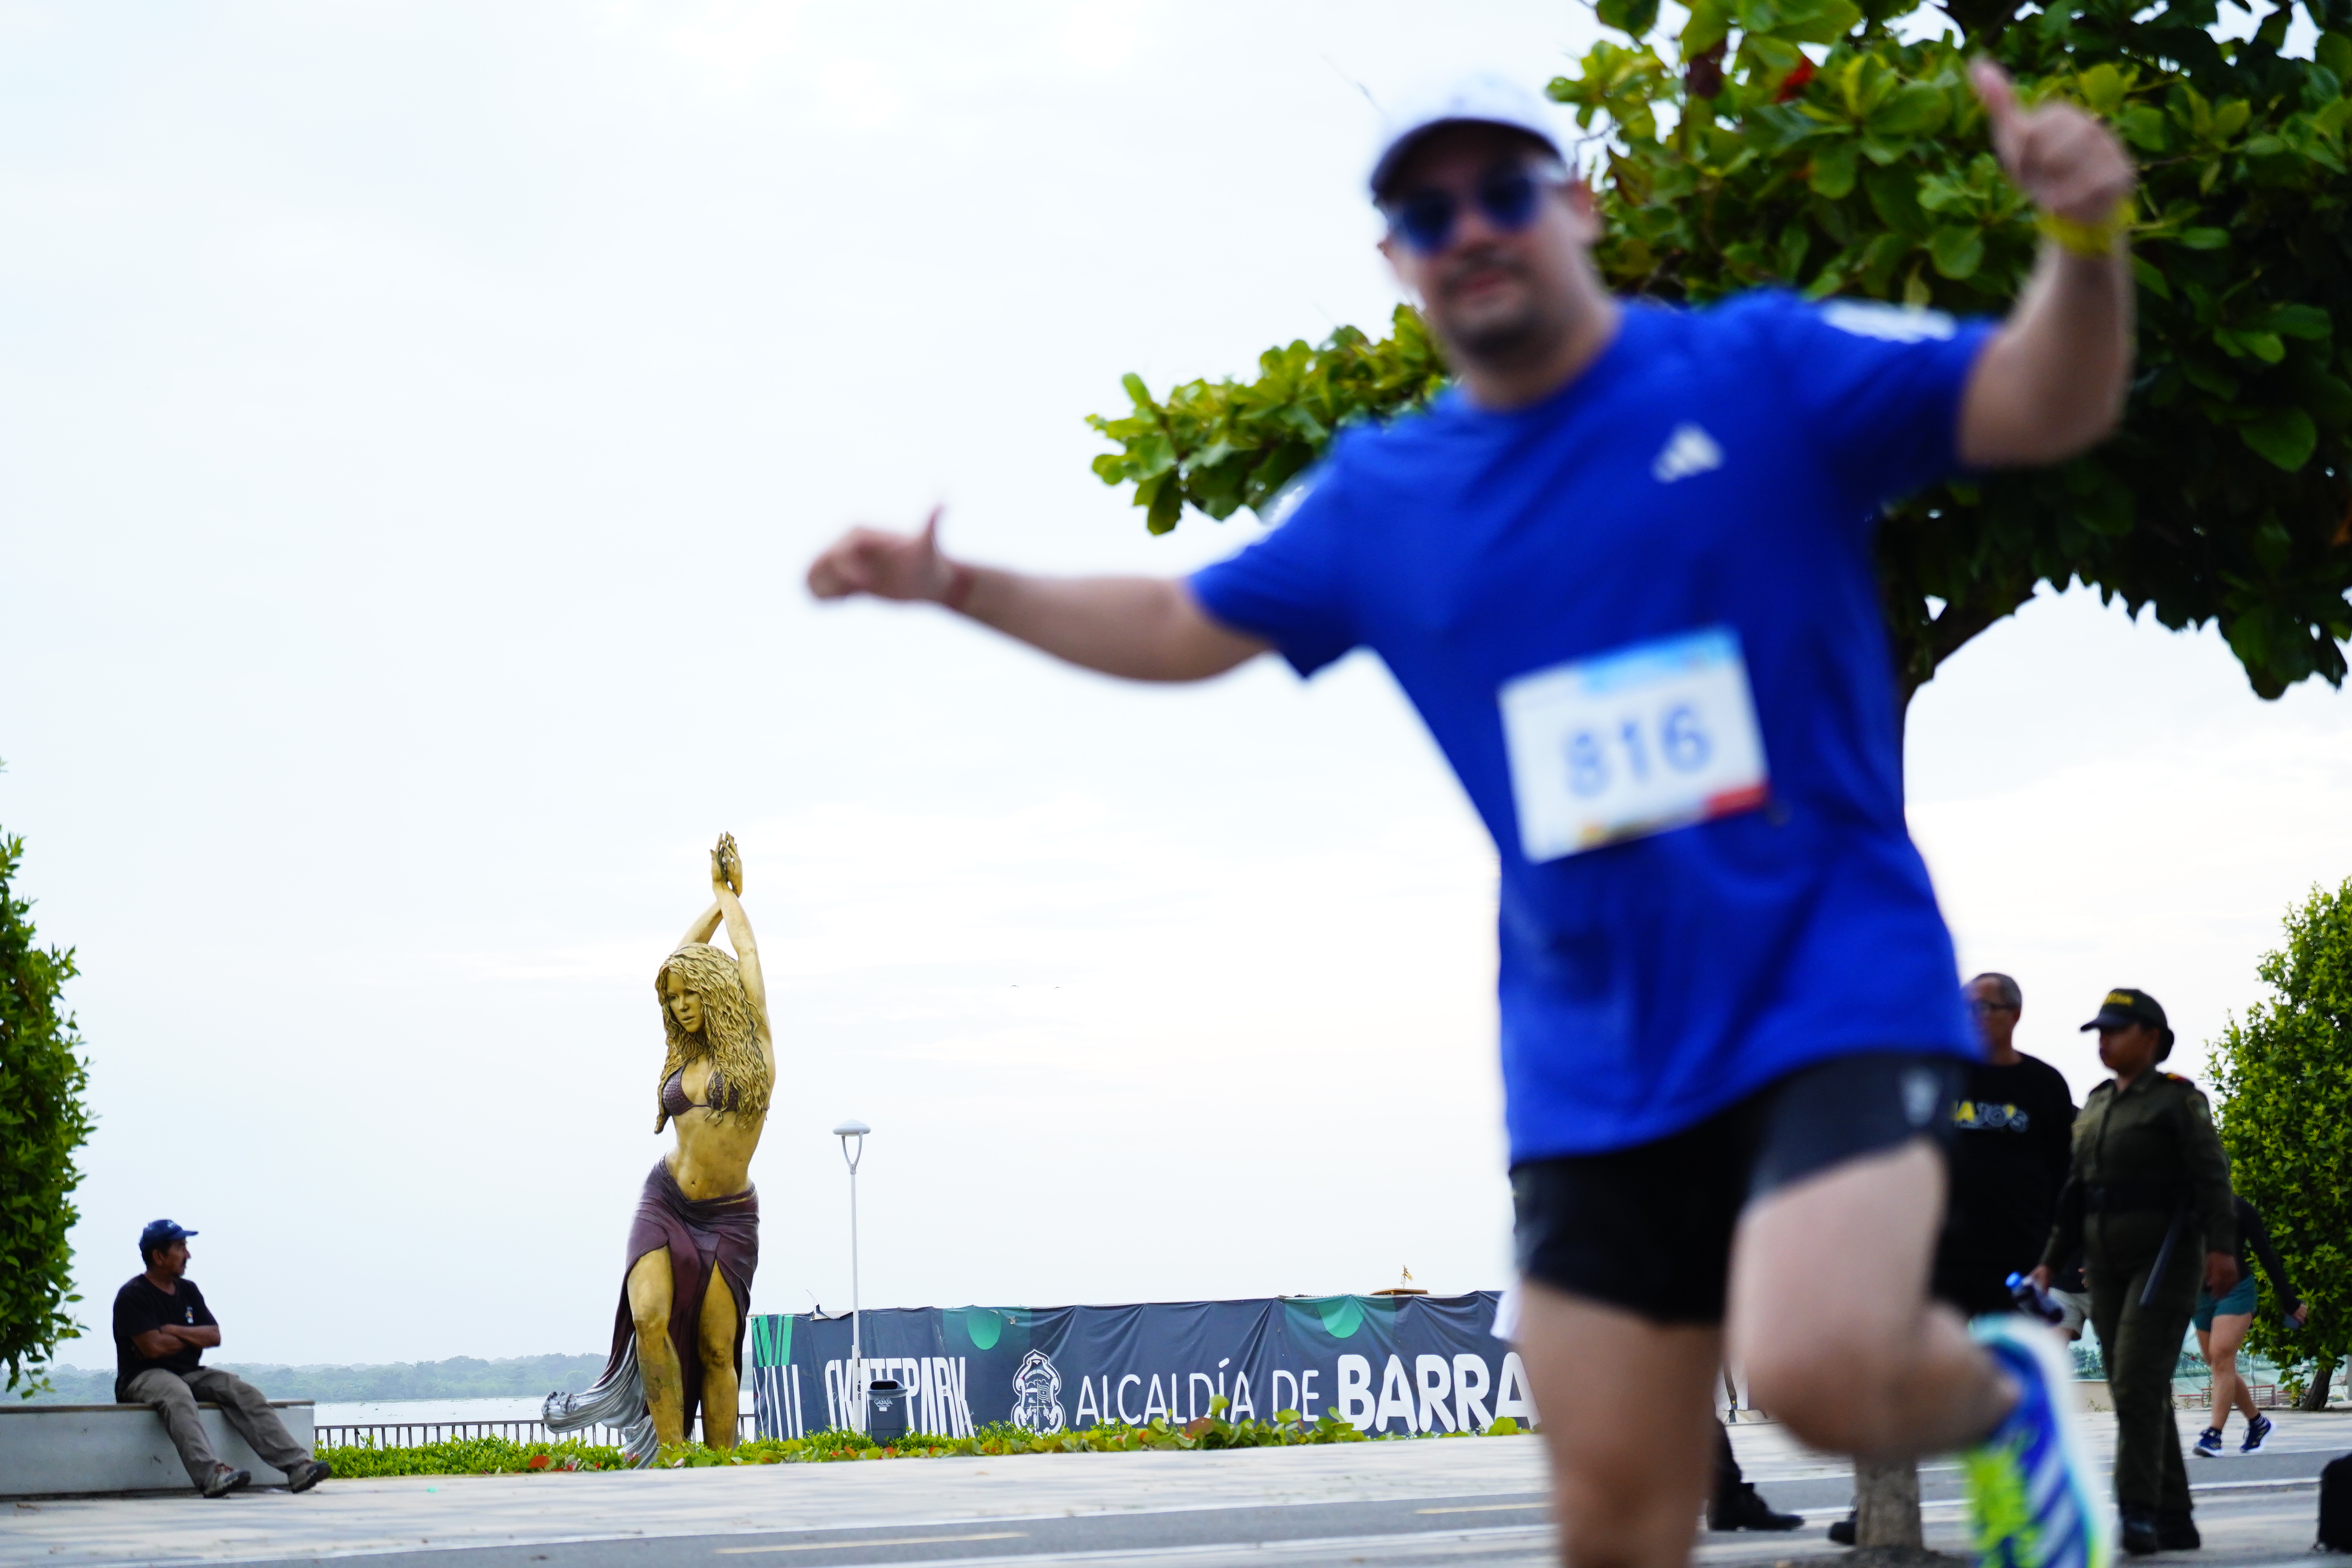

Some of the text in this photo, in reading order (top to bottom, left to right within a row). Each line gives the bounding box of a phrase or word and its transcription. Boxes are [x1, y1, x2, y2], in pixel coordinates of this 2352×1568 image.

[1561, 703, 1713, 800] 816
[1076, 1358, 1255, 1427] ALCALDÍA
[1272, 1370, 1319, 1422] DE
